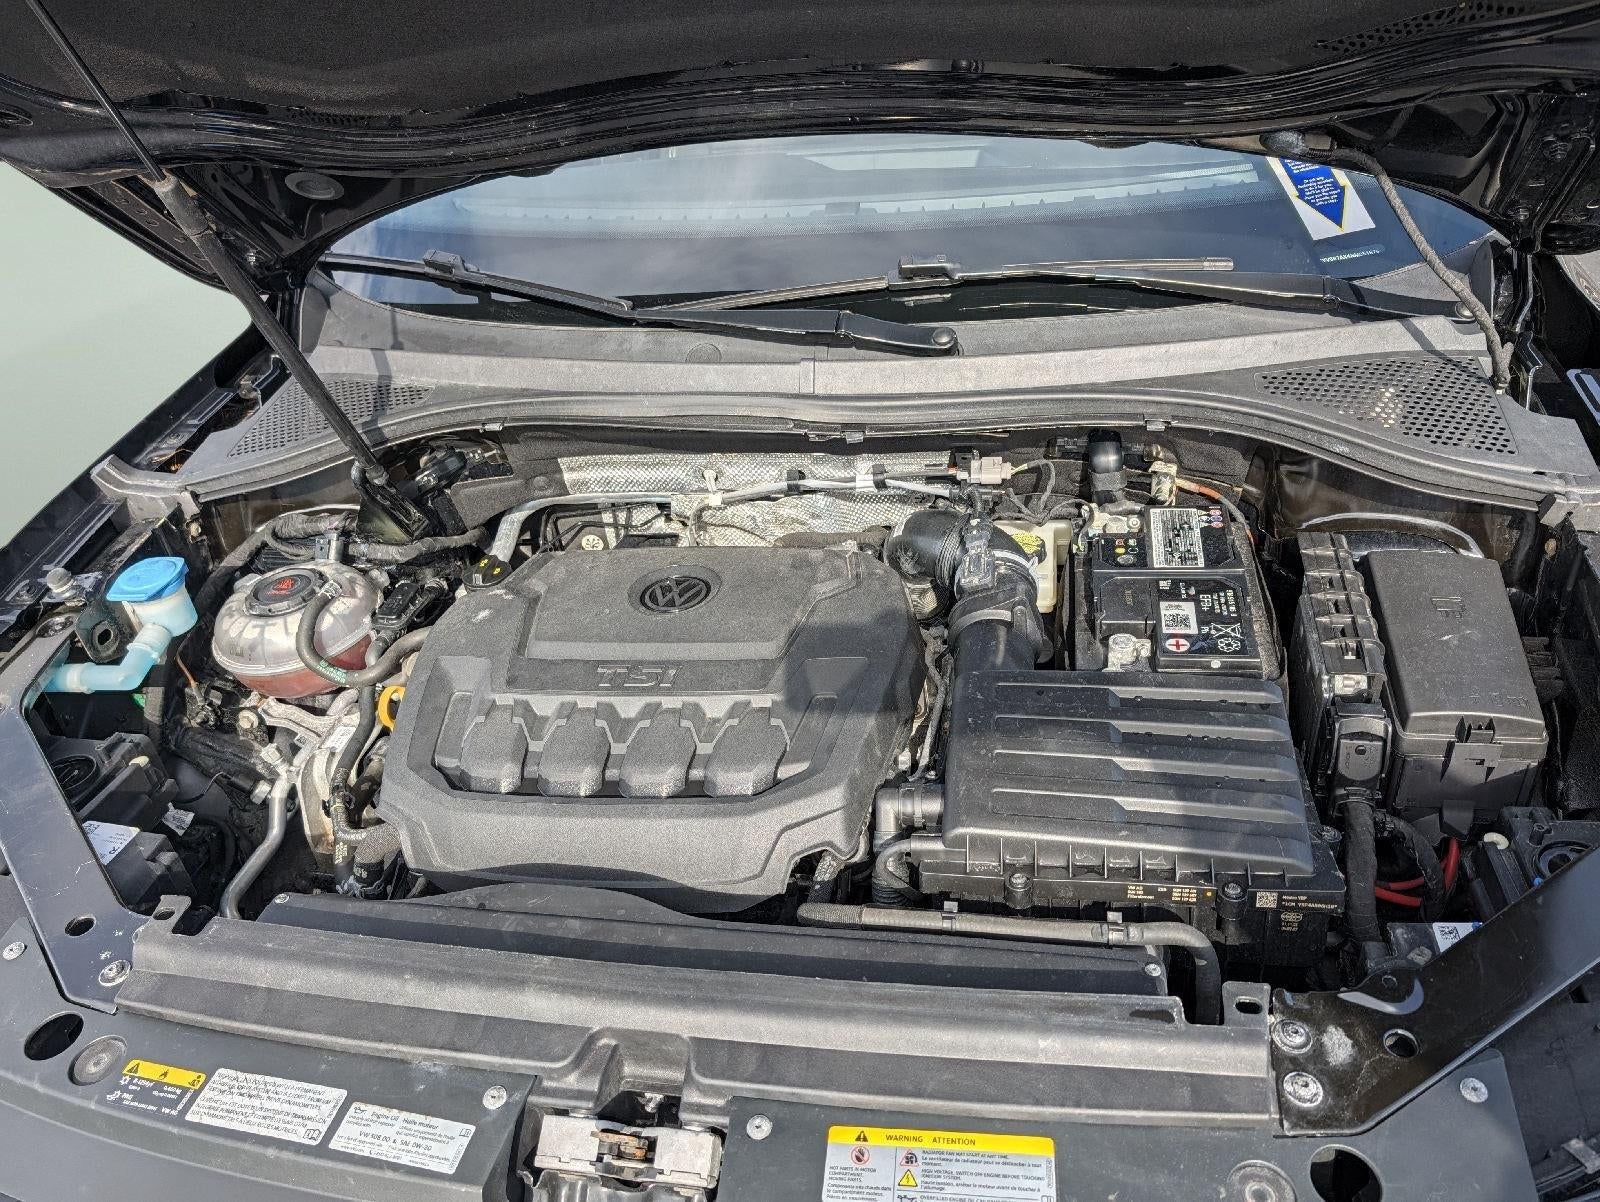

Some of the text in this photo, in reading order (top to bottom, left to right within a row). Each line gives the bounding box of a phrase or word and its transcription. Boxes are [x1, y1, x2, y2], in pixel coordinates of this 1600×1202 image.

[597, 665, 682, 687] TSI
[360, 1130, 370, 1138] VW
[886, 1134, 976, 1146] WARNING ATTENTION
